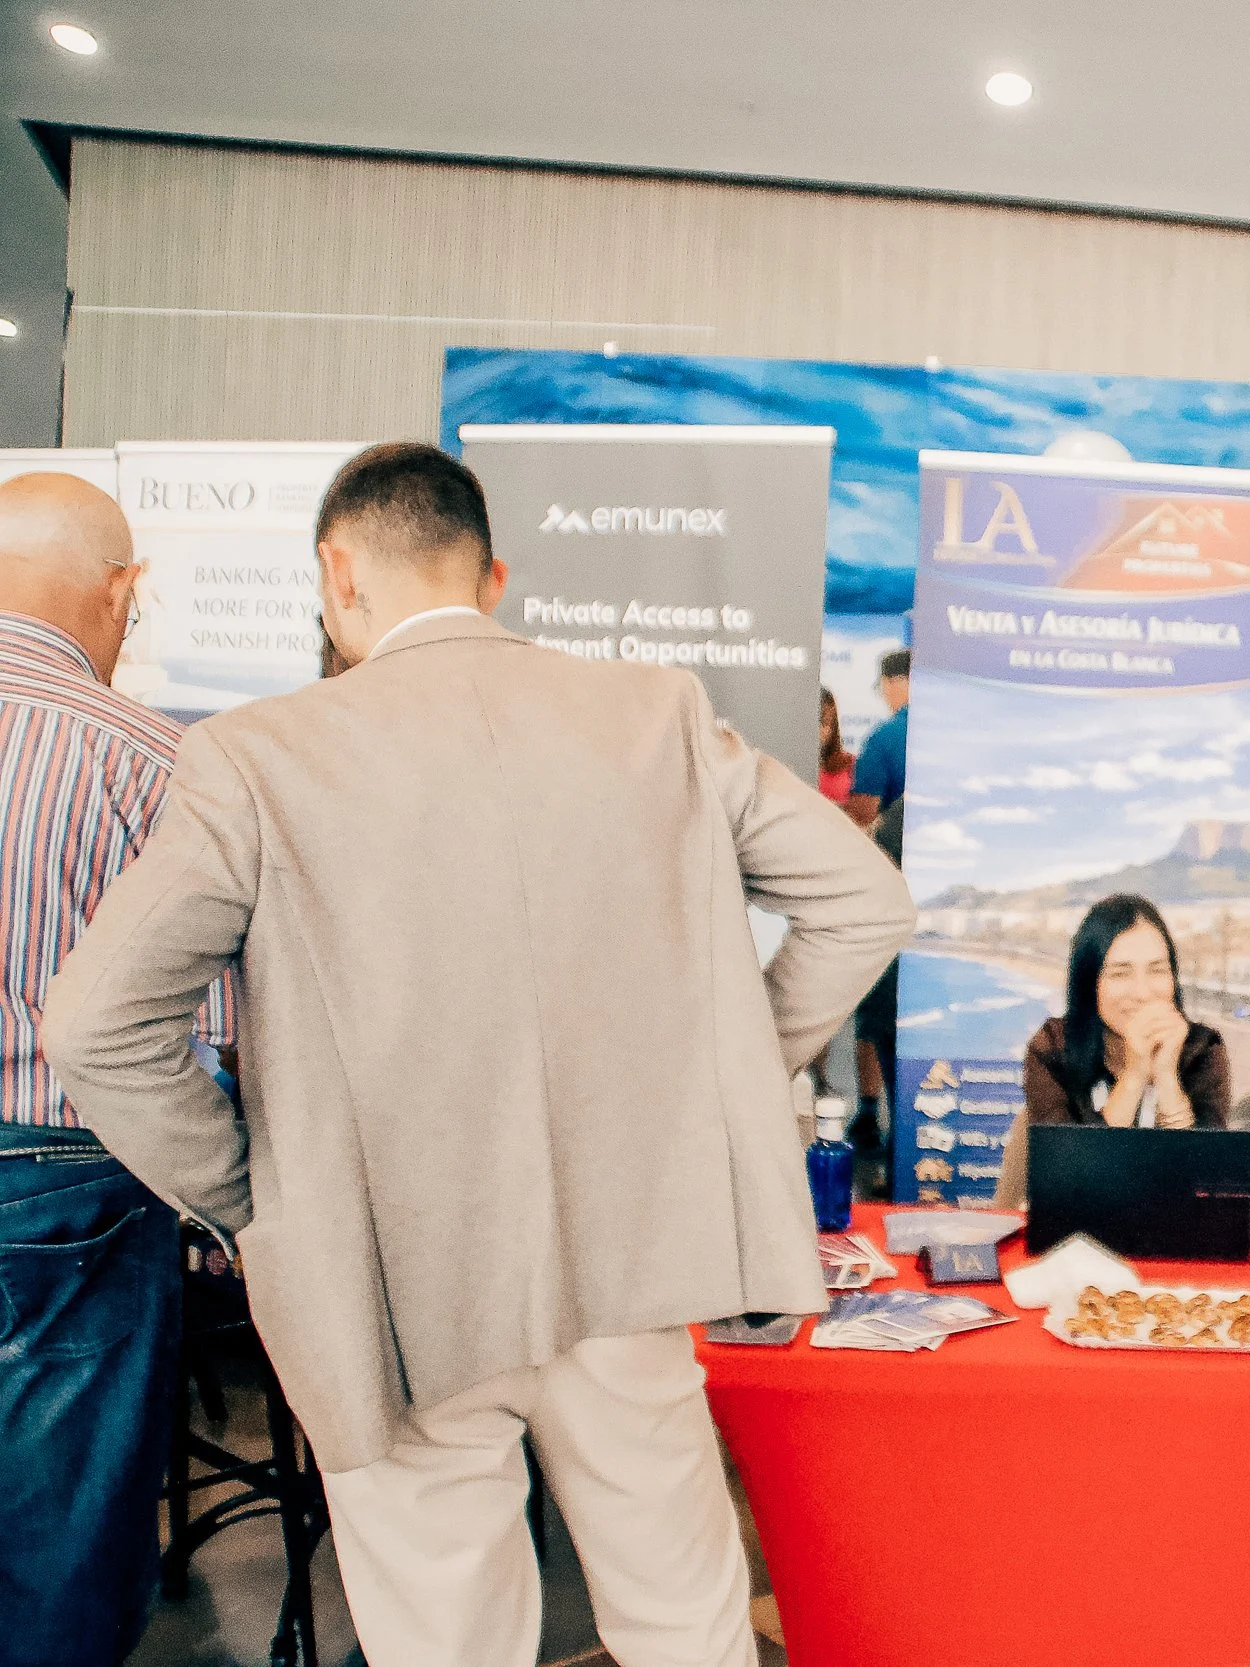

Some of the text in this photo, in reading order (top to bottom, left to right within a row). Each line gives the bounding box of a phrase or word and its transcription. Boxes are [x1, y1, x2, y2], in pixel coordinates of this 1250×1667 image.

[139, 477, 255, 511] BUENO
[591, 506, 727, 533] emunex
[940, 477, 1038, 552] LA
[194, 565, 281, 585] BANKING
[191, 597, 247, 617] MORE
[255, 598, 293, 618] FOR
[523, 597, 752, 631] Private Access to
[190, 629, 270, 649] SPANISH
[619, 635, 806, 668] Opportunities
